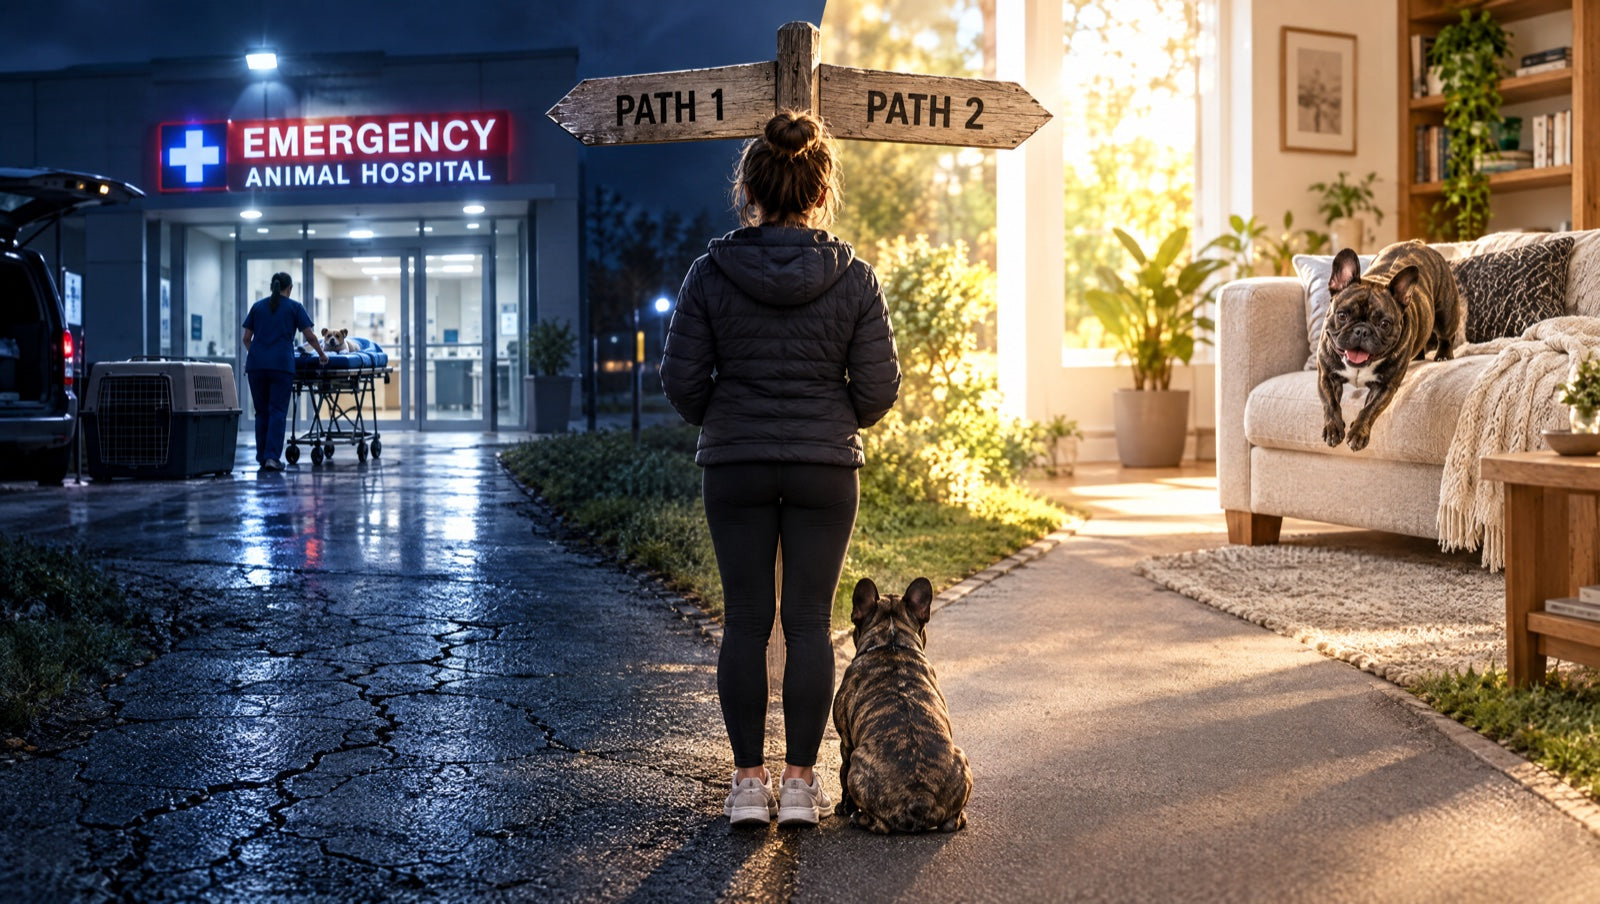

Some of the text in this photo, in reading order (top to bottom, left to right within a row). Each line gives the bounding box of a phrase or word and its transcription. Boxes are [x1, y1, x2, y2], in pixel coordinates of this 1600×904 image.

[616, 88, 724, 127] PATH 1
[868, 90, 985, 130] PATH 2
[243, 119, 496, 158] EMERGENCY
[246, 161, 491, 187] ANIMAL HOSPITAL
